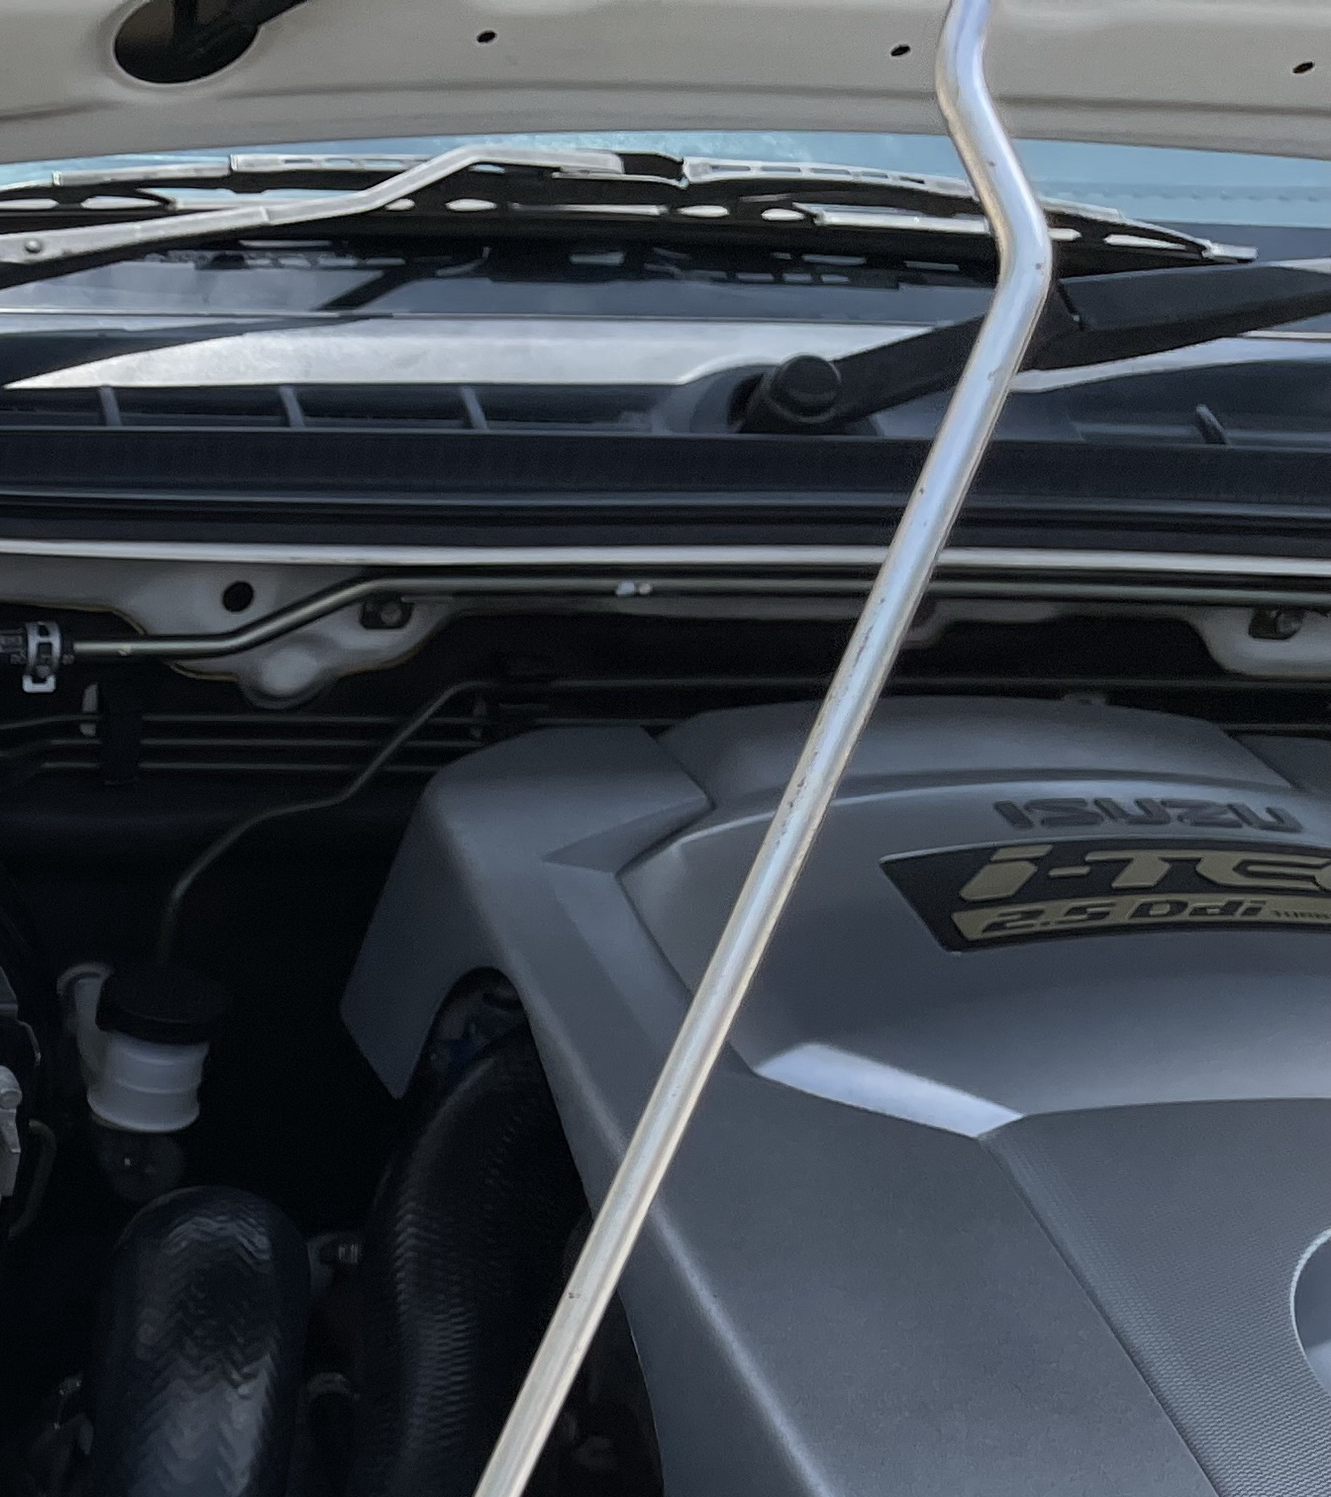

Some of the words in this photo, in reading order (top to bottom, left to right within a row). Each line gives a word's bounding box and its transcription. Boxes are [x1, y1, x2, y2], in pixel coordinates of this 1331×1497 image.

[992, 796, 1305, 834] ISUZU
[981, 901, 1118, 934] 2.5
[1128, 897, 1268, 921] Ddi
